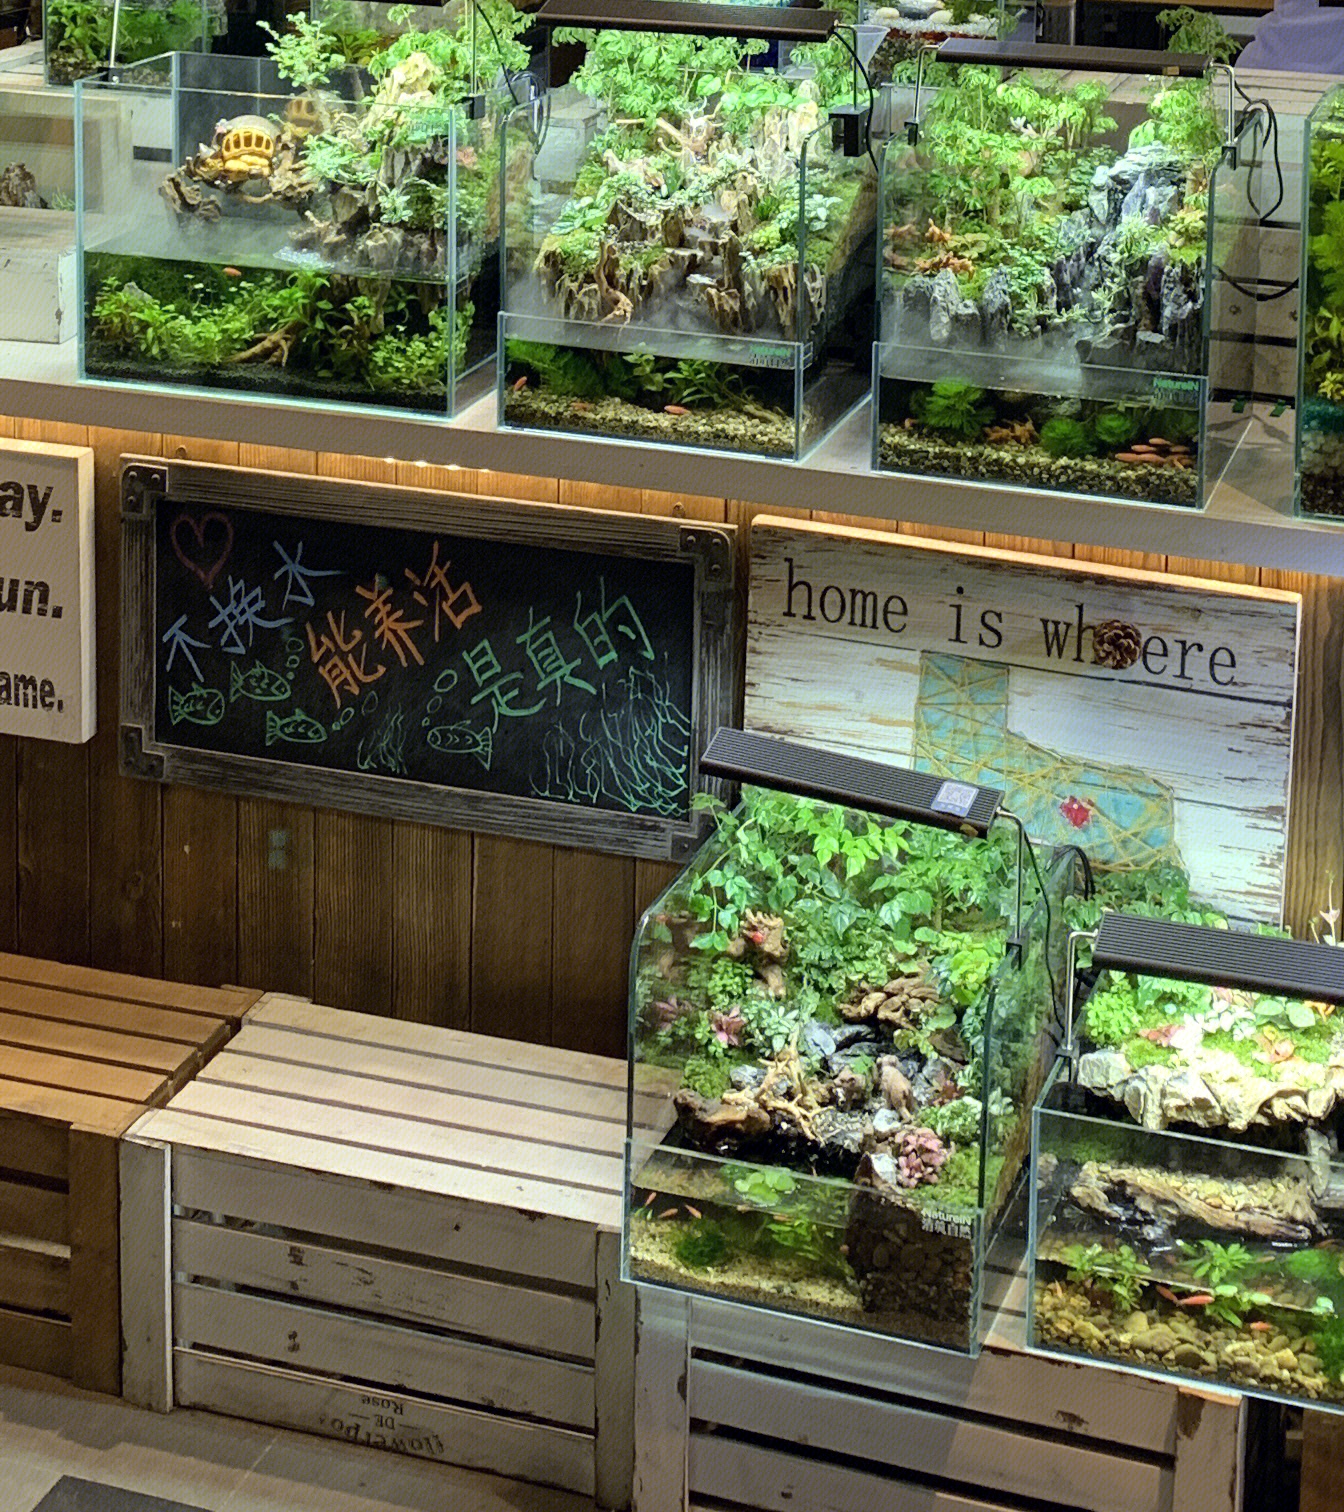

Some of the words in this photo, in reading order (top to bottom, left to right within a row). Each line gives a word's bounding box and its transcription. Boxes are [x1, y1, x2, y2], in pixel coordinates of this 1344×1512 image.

[162, 540, 348, 682] 不换水
[306, 540, 484, 708] 能养活
[462, 576, 656, 732] 是真的
[783, 558, 909, 634] home
[948, 586, 1003, 649] is
[362, 1395, 404, 1416] Rose
[375, 1414, 395, 1430] DE
